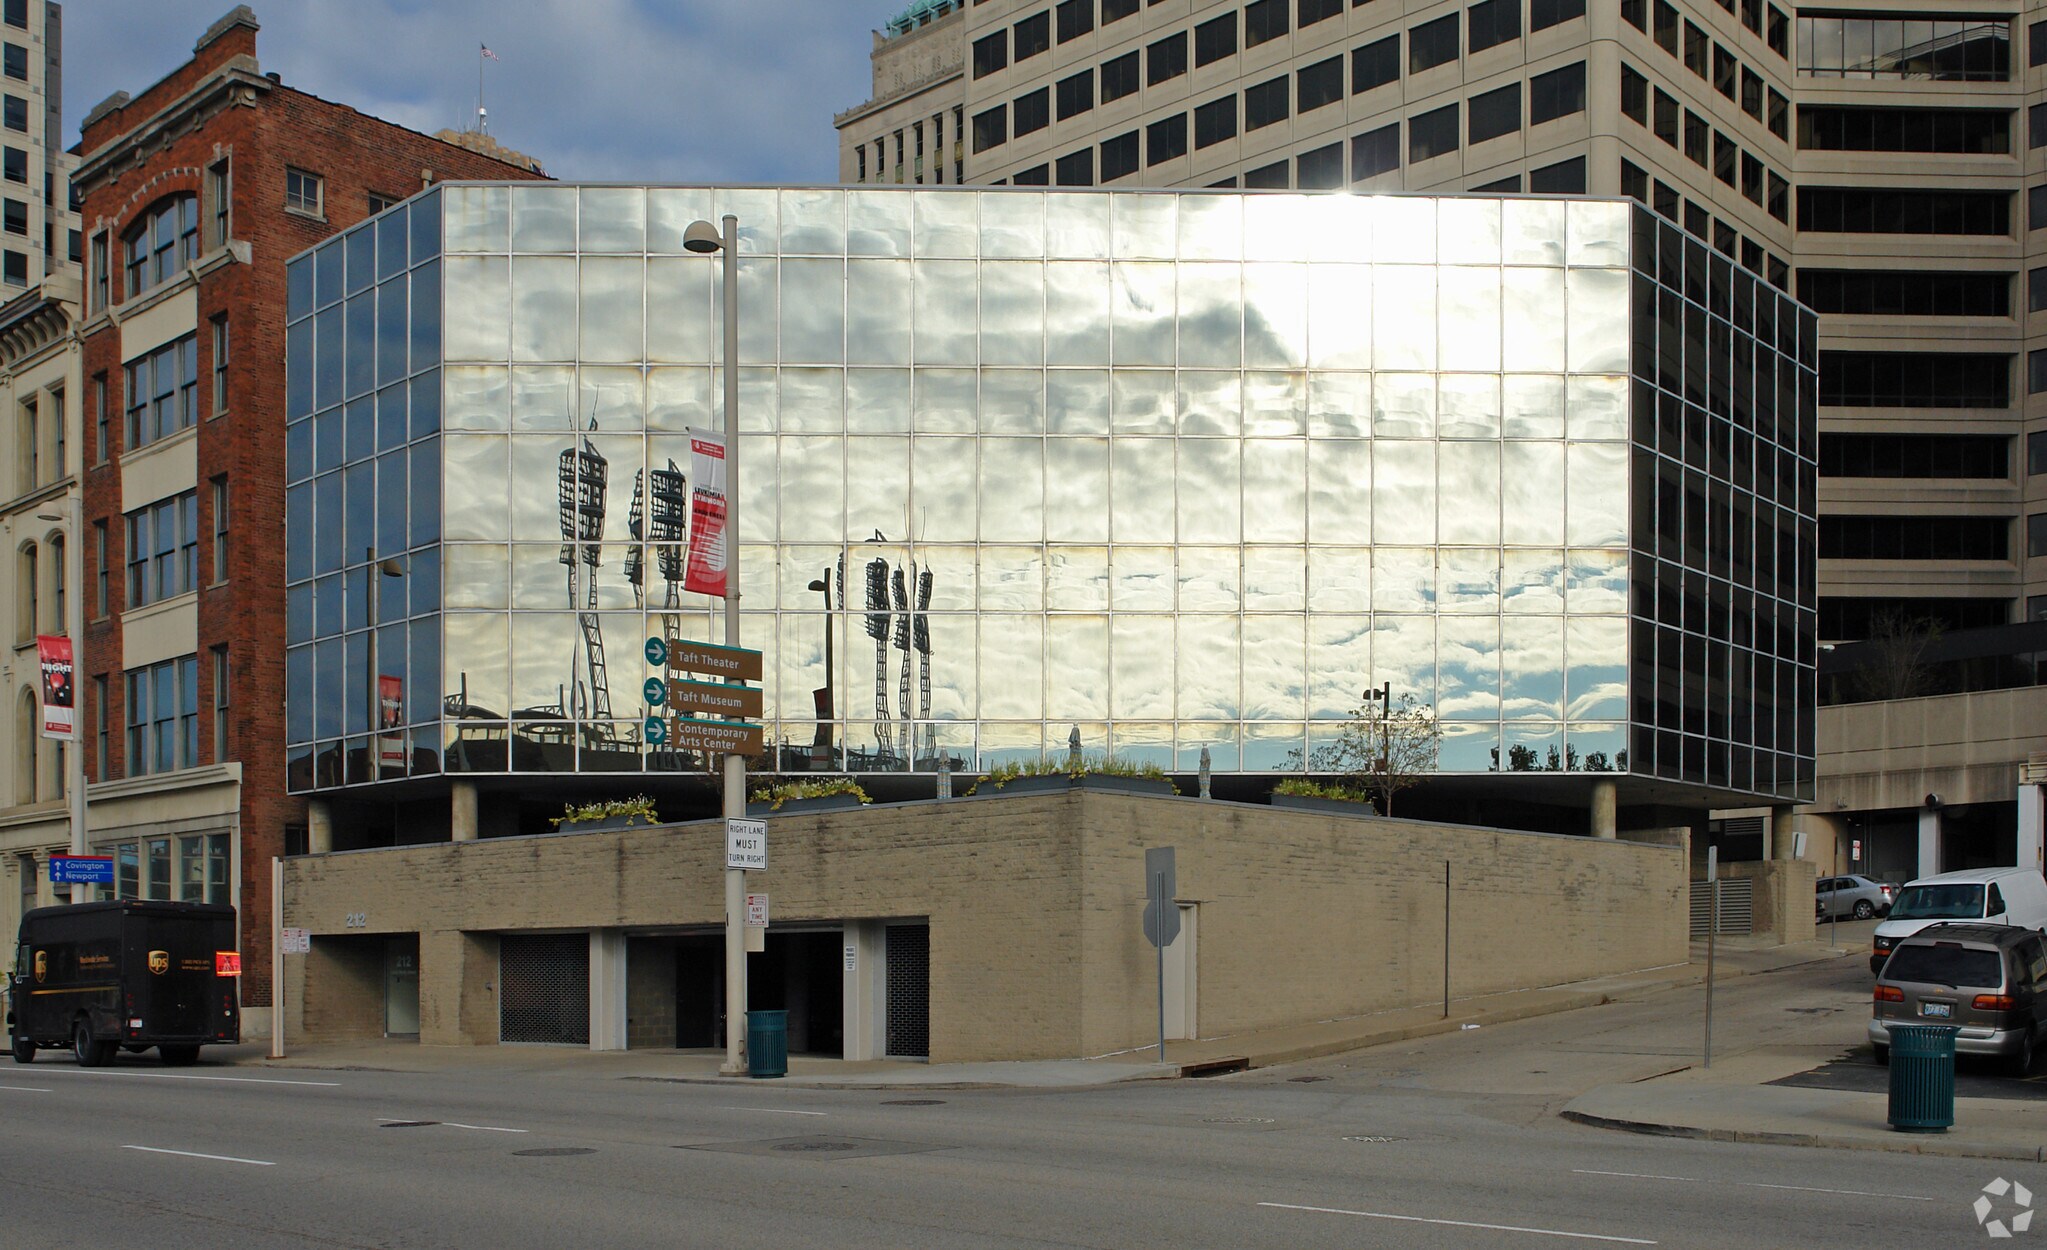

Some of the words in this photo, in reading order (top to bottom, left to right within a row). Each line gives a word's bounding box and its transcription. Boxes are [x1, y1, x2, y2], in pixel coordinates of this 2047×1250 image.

[678, 651, 699, 664] Taft
[701, 654, 739, 669] Theater
[42, 663, 72, 673] NIGHT
[678, 691, 699, 703] Taft
[701, 693, 742, 707] Museum
[678, 723, 748, 741] Contemporary
[679, 735, 700, 748] Arts
[703, 738, 736, 750] Center
[730, 825, 747, 834] RIGHT
[749, 827, 764, 835] LANE
[736, 839, 757, 849] MUST
[729, 854, 745, 862] TURN
[747, 855, 764, 863] RIGHT
[65, 861, 105, 870] Covington
[65, 871, 99, 880] Newport
[346, 912, 367, 928] 212
[151, 958, 168, 971] ups
[396, 956, 412, 967] 212
